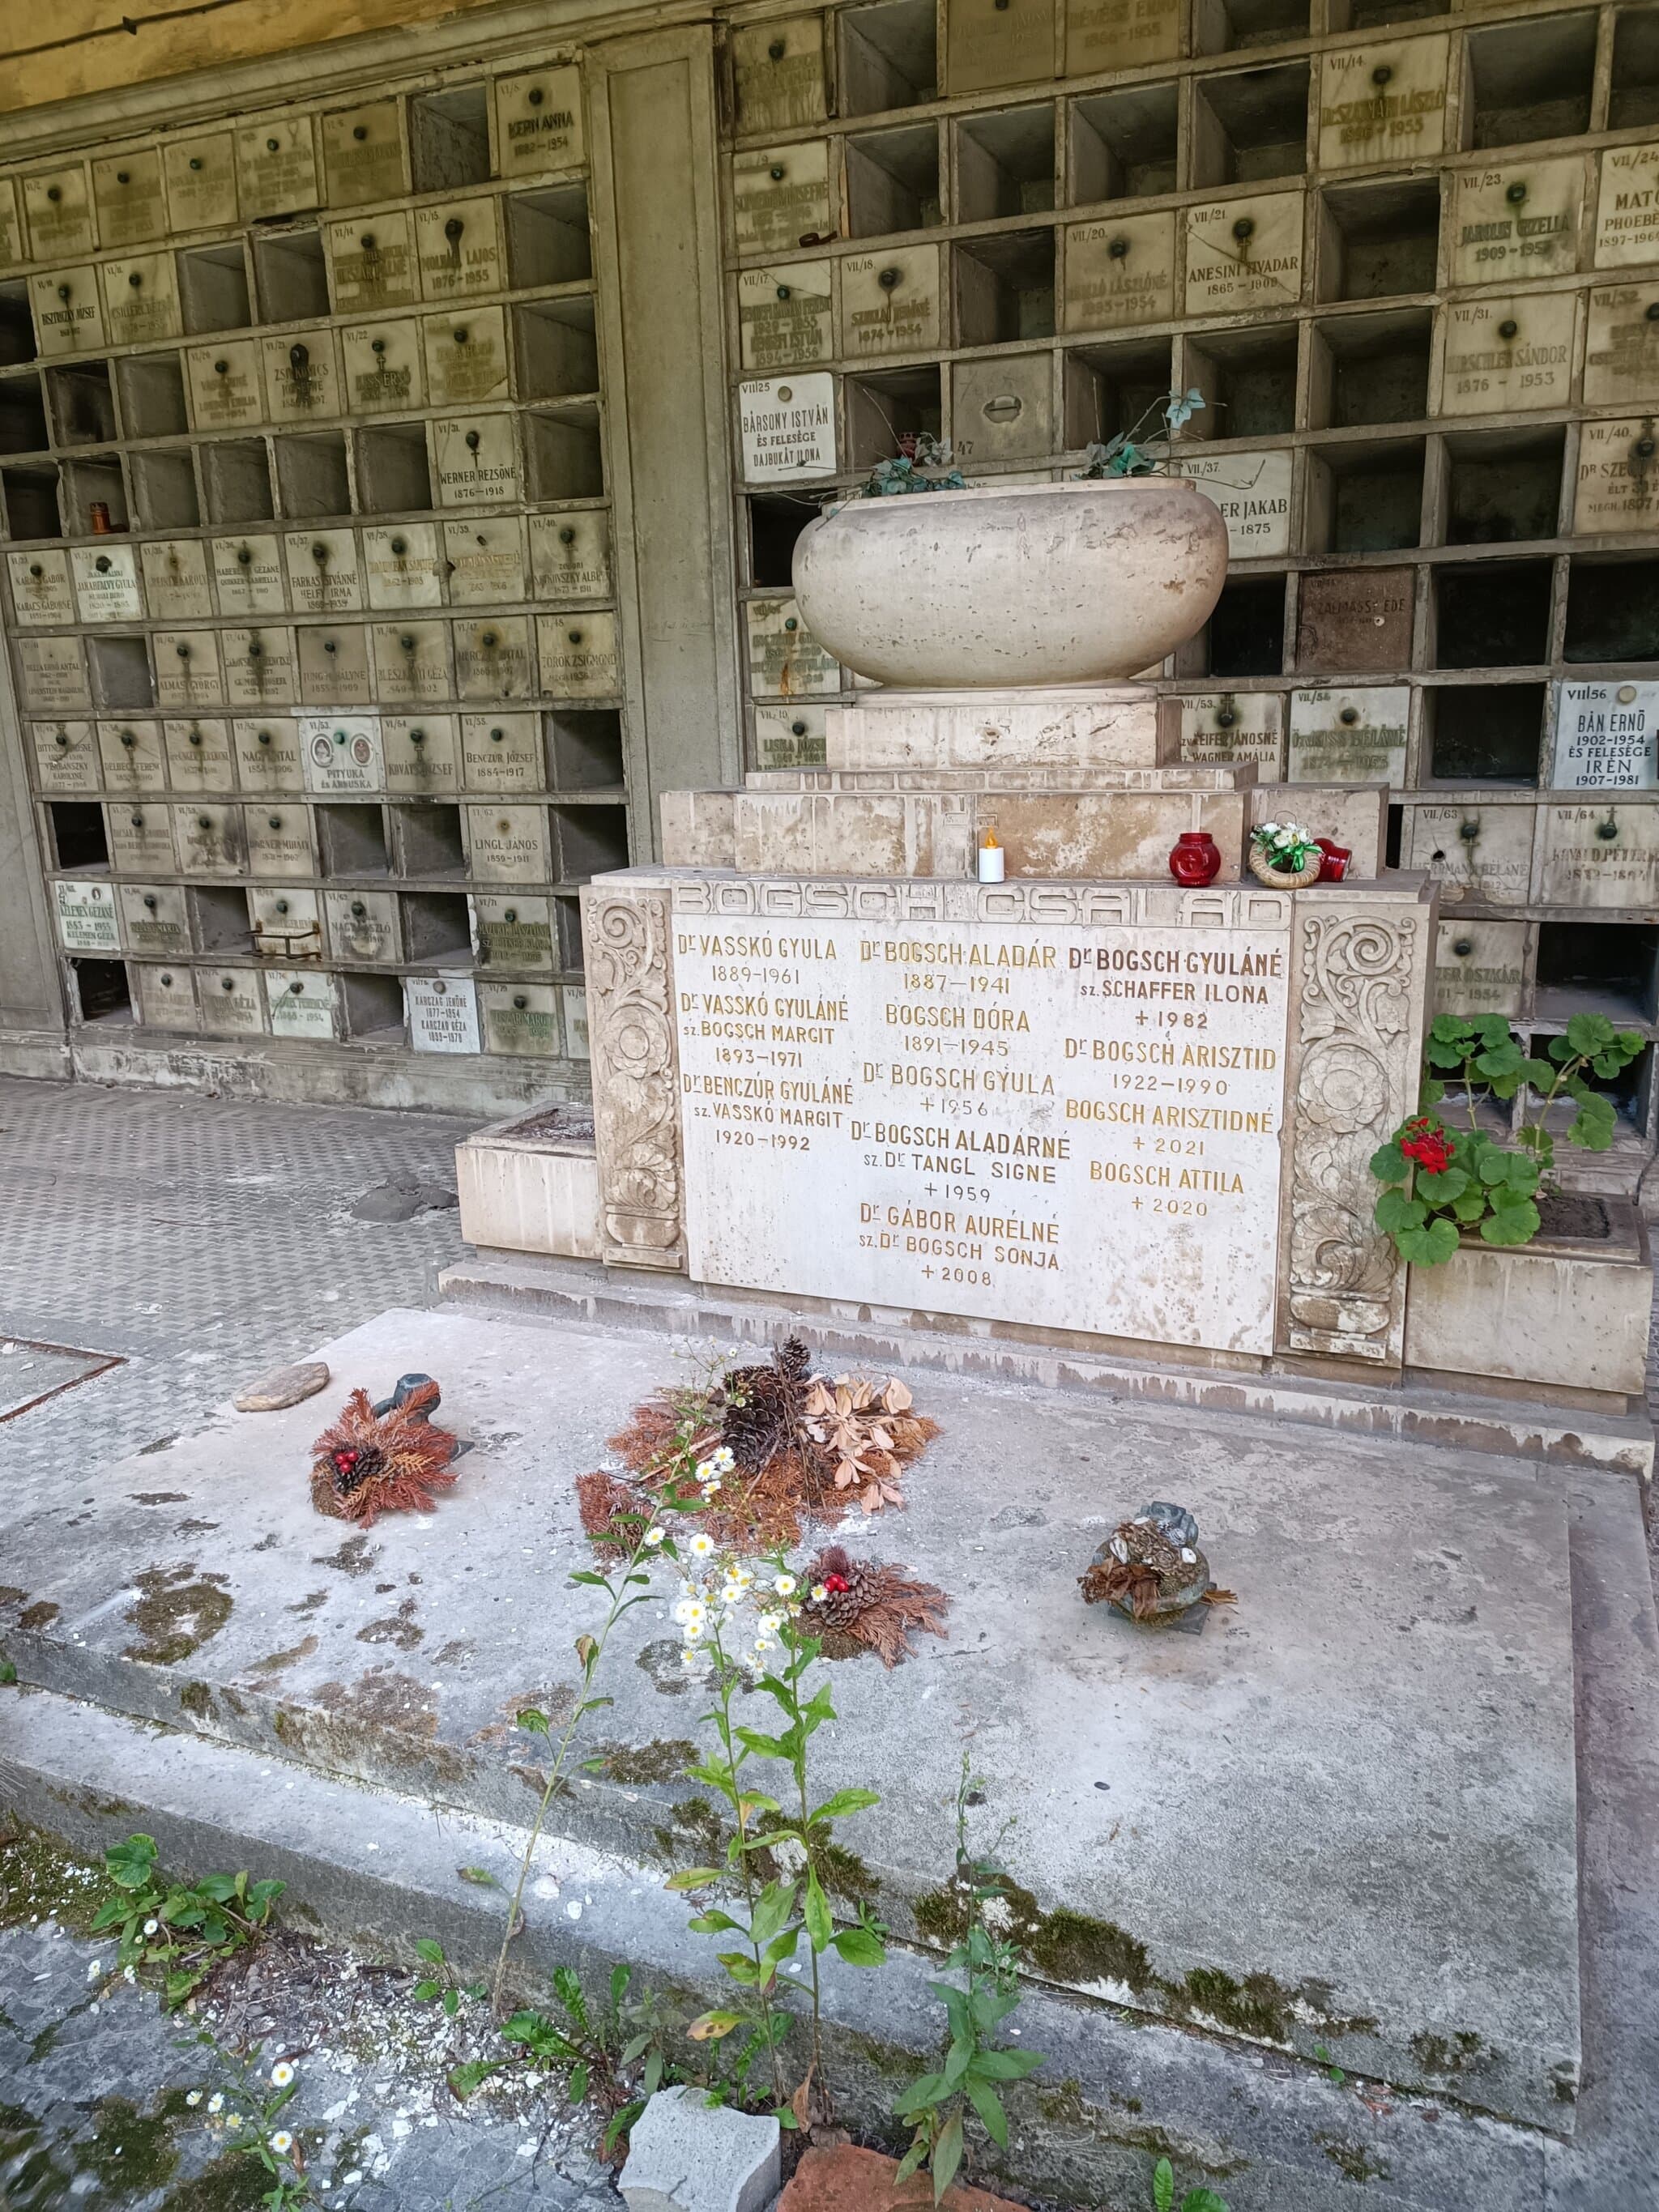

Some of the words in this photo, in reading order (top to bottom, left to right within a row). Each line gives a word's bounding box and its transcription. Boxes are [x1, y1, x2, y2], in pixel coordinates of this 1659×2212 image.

[1463, 171, 1505, 193] VII./23.
[1188, 264, 1240, 283] ANESINI
[1515, 342, 1567, 369] SÁNDOR
[1520, 371, 1555, 389] 1953
[743, 409, 787, 434] BÁRSONY
[791, 403, 829, 428] ISTVÁN
[757, 431, 768, 448] ÉS
[770, 429, 817, 446] FELESÉGE
[957, 441, 974, 454] 47
[440, 471, 476, 485] WERNER
[1243, 497, 1288, 520] JAKAB
[291, 576, 321, 588] FARKAS
[331, 586, 352, 598] IRMA
[1384, 599, 1406, 612] EDE
[1578, 710, 1605, 733] BÁN
[1568, 745, 1583, 758] ÉS
[1587, 744, 1652, 758] FELESÉGE
[1576, 734, 1646, 746] 1902-1954
[466, 750, 503, 764] BENCZÚR
[506, 750, 535, 764] JÓZSEF
[1585, 756, 1632, 774] IRÉN
[326, 768, 365, 779] PITYUKA
[1576, 775, 1640, 786] 1907-1981
[475, 839, 504, 850] LINGL
[505, 835, 539, 850] JÁNOS
[672, 880, 946, 922] BOGSCH
[678, 935, 696, 954] Dr
[699, 930, 772, 957] VASSKÓ
[778, 938, 837, 960] GYULA
[859, 940, 881, 962] Dr
[884, 941, 962, 965] BOGSCH
[969, 938, 1057, 969] ALADÁR
[1068, 947, 1092, 970] Dr
[1096, 948, 1179, 973] BOGSCH
[1186, 945, 1283, 977] GYULÁNÉ
[711, 965, 800, 985] 1889-1961
[1102, 979, 1196, 1001] SCHAFFER
[1205, 983, 1269, 1004] ILONA
[680, 992, 699, 1012] Dr
[702, 991, 769, 1016] VASSKÓ
[774, 994, 849, 1021] GYULÁNÉ
[885, 1004, 966, 1028] BOGSCH
[973, 1001, 1030, 1033] DÓRA
[702, 1021, 766, 1041] BOGSCH
[771, 1025, 834, 1044] MARGIT
[716, 1046, 802, 1068] 1893-1971
[1065, 1038, 1087, 1059] Dr
[1093, 1039, 1175, 1065] BOGSCH
[1182, 1044, 1277, 1071] ARISZTID
[684, 1073, 702, 1093] Dr
[703, 1071, 774, 1099] BENCZÚR
[780, 1076, 853, 1105] GYULÁNÉ
[864, 1062, 885, 1083] Dr
[891, 1063, 976, 1091] BOGSCH
[983, 1070, 1056, 1097] GYULA
[1113, 1073, 1229, 1096] 1922-1990
[713, 1101, 774, 1123] VASSKÓ
[780, 1110, 843, 1129] MARGIT
[1065, 1098, 1145, 1124] BOGSCH
[1152, 1103, 1274, 1134] ARISZTIDNÉ
[715, 1129, 811, 1152] 1920-1992
[851, 1121, 872, 1141] Dr
[875, 1122, 950, 1149] BOGSCH
[954, 1127, 1071, 1160] ALADÁRNÉ
[911, 1153, 976, 1176] TANGL
[991, 1161, 1057, 1184] SIGNE
[1090, 1160, 1171, 1187] BOGSCH
[1179, 1168, 1245, 1195] ATTILA
[859, 1202, 881, 1224] Dr
[887, 1199, 957, 1234] GÁBOR
[965, 1209, 1060, 1245] AURÉLNÉ
[906, 1236, 983, 1260] BOGSCH
[994, 1245, 1060, 1271] SONJA
